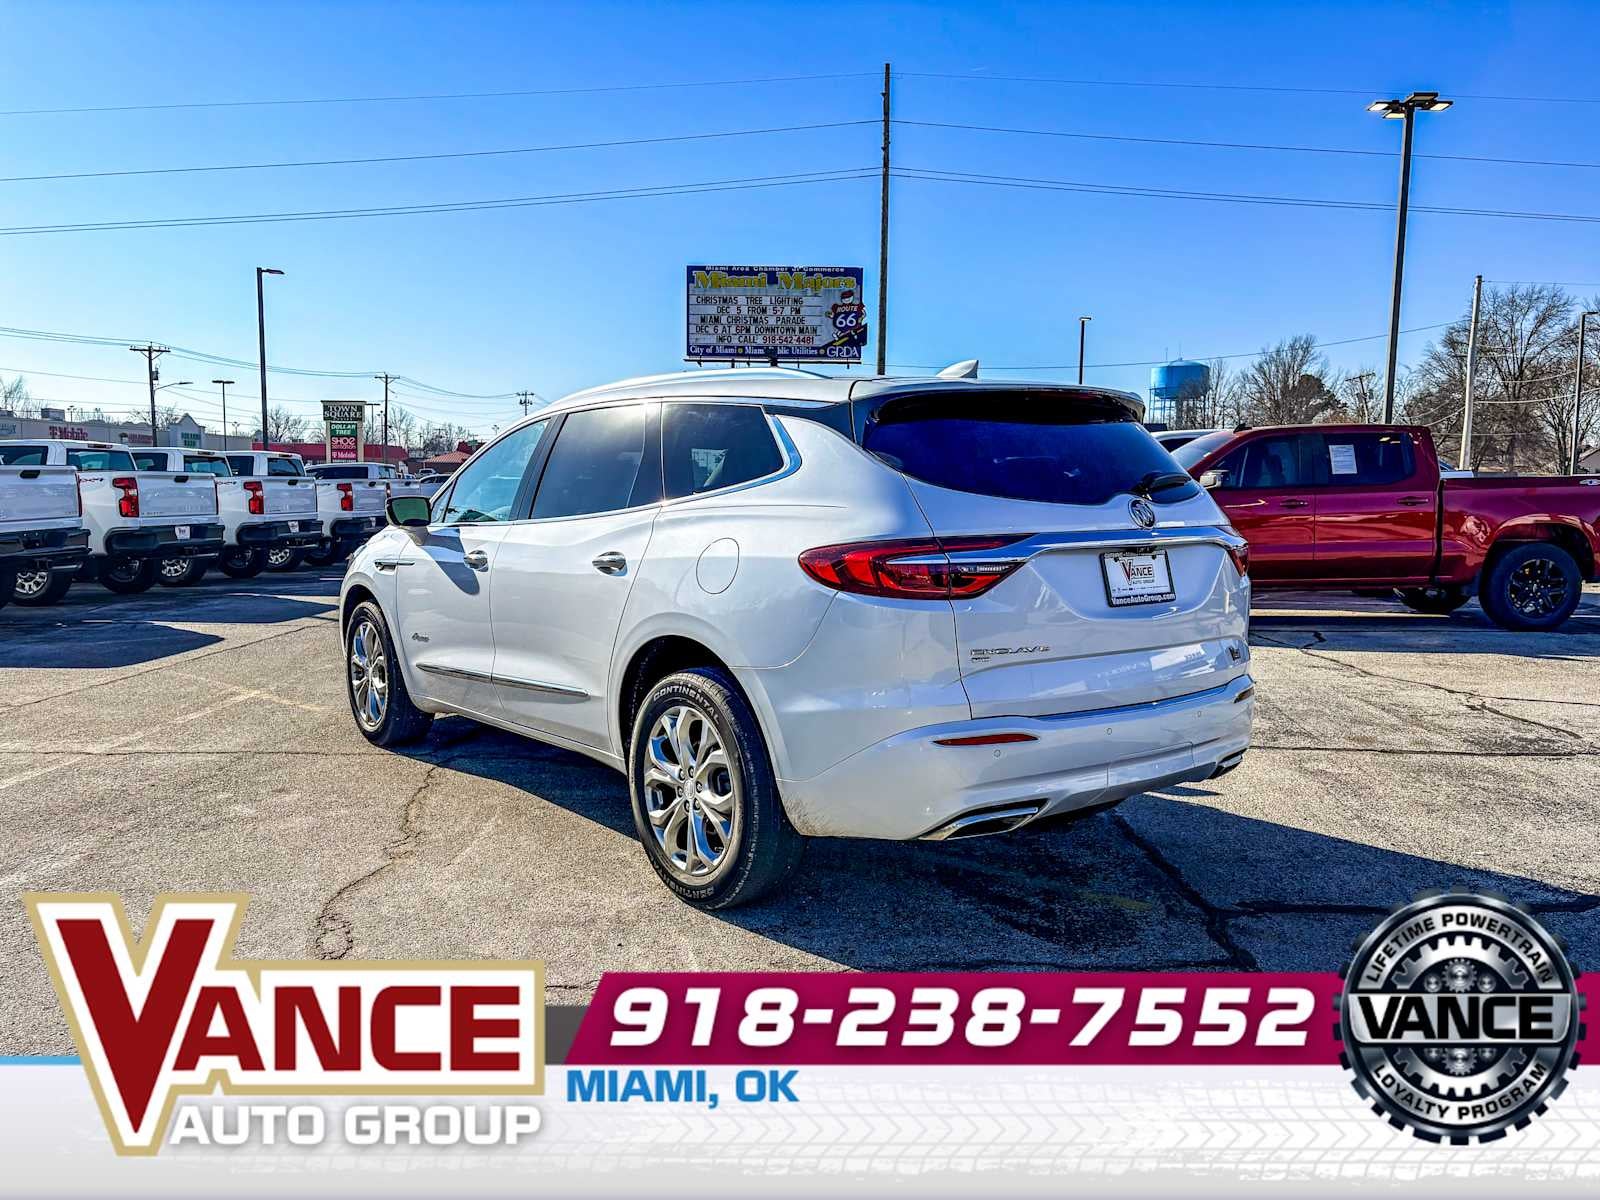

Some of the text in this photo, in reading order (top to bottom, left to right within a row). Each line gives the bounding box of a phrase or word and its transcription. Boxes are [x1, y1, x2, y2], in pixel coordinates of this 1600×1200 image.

[776, 272, 857, 294] Majors
[696, 296, 804, 305] CHRISTMAS TREE LIGHTING
[716, 305, 801, 315] DEC 5 FROM 5-7 PM
[836, 305, 858, 313] ROUTE
[700, 315, 806, 325] MIAMI CHRISTMAS PARADE
[836, 313, 857, 328] 66
[695, 325, 818, 335] DEC 6 AT 6PM DOWNTOWN MAIN
[716, 335, 732, 343] INFO
[738, 335, 757, 344] CALL
[689, 345, 737, 355] City of Miami
[791, 345, 818, 355] Utilities
[826, 346, 860, 357] GRDA
[324, 410, 362, 419] SQUARE
[1121, 560, 1153, 582] VANCE
[1111, 593, 1176, 605] VanceAutoGroup.com
[970, 646, 1050, 655] ENCLAVE
[653, 685, 720, 724] CONTINENTAL
